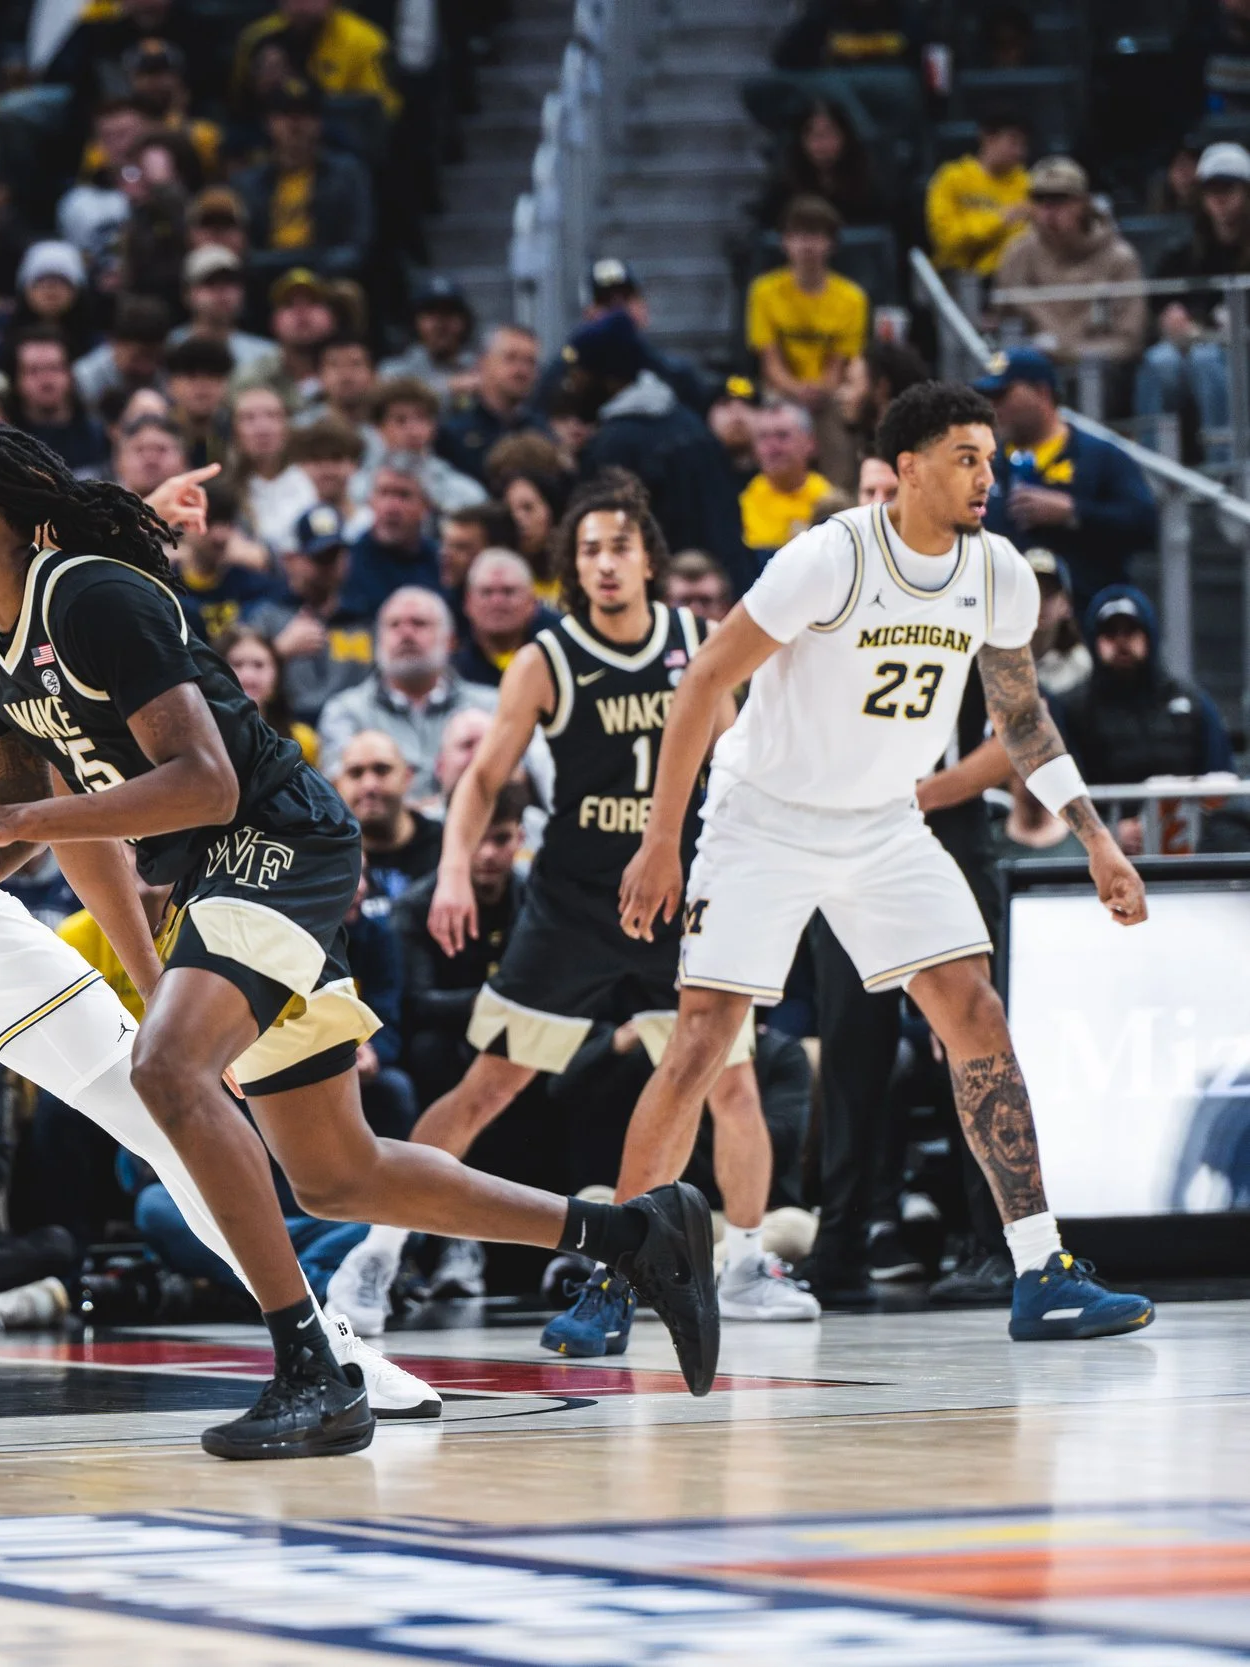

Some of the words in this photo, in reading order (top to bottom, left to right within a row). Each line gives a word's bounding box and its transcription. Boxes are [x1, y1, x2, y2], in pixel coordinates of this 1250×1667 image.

[857, 624, 972, 654] MICHIGAN
[862, 661, 944, 720] 23
[3, 695, 82, 740] WAKE
[632, 736, 651, 792] 1
[578, 796, 652, 834] FORE
[206, 826, 295, 891] WF
